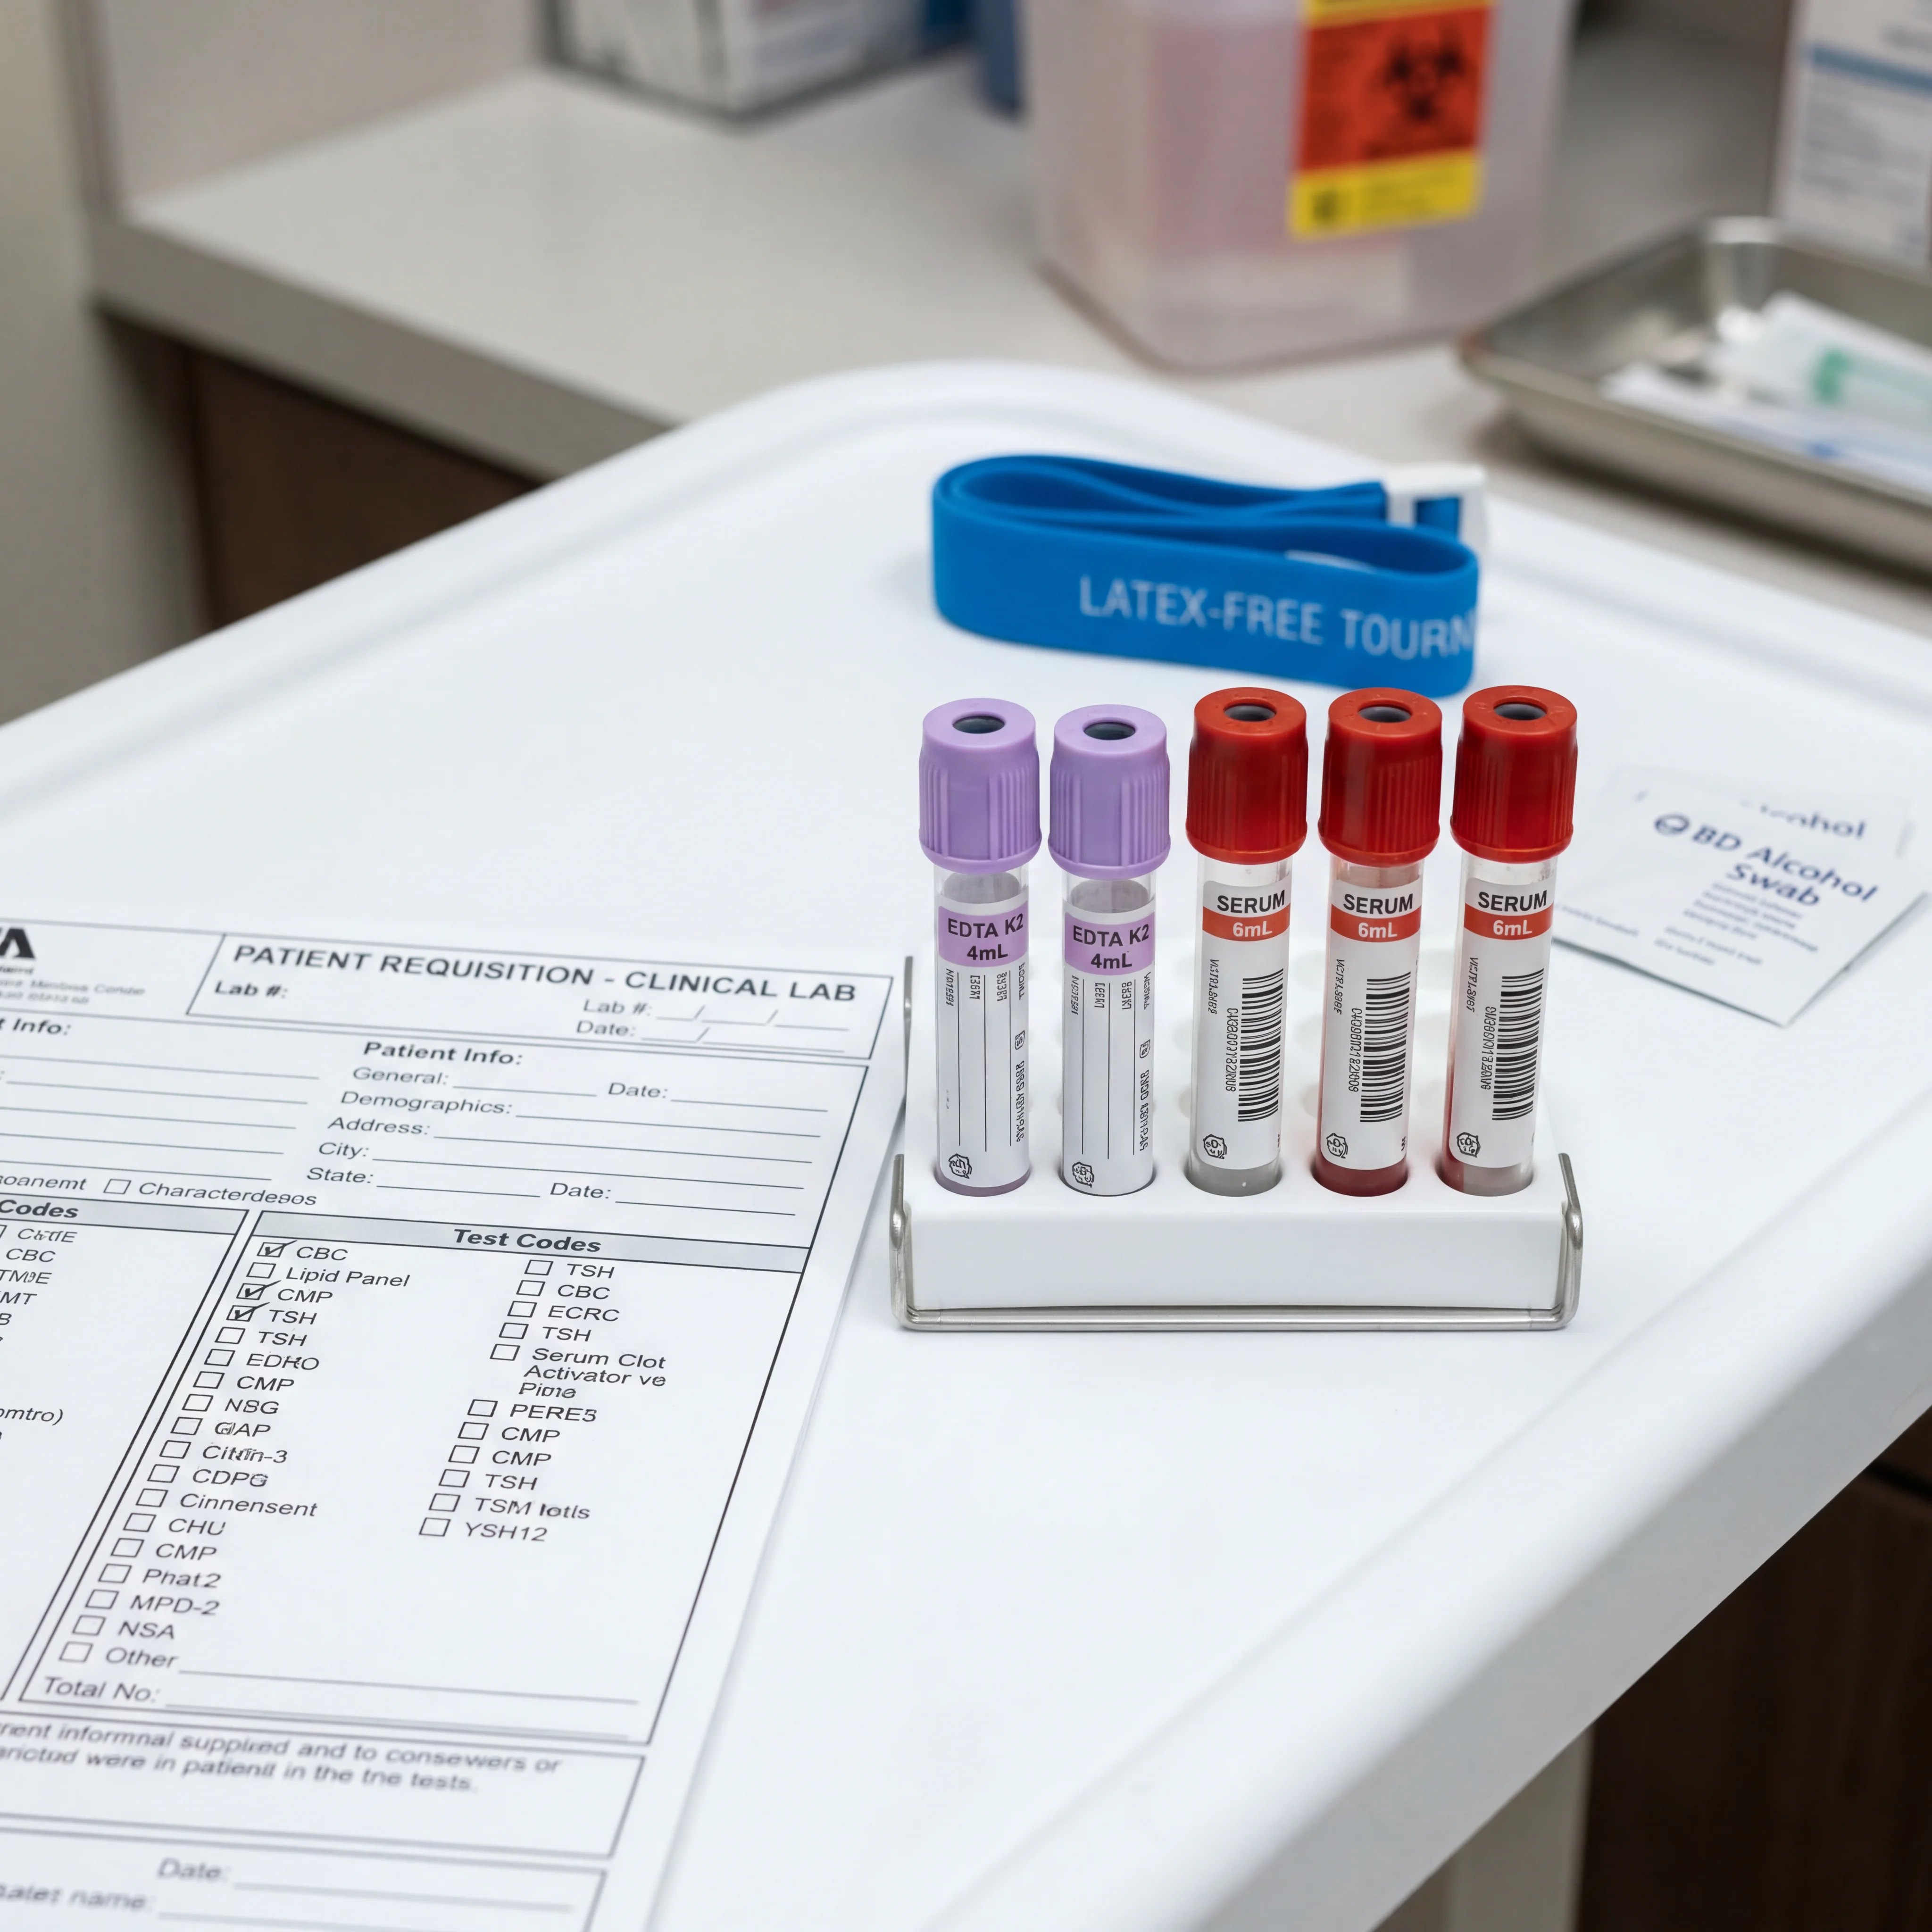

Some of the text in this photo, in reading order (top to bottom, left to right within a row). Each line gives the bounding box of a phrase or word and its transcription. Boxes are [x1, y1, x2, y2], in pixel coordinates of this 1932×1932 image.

[1079, 575, 1324, 645] LATEX-FREE
[1691, 825, 1878, 901] BD Alcohol
[1725, 863, 1820, 906] Swab
[1217, 890, 1285, 914] SERUM
[1343, 893, 1413, 915] SERUM
[1478, 890, 1547, 912] SERUM
[948, 913, 1023, 938] EDTA K2
[1233, 921, 1272, 937] 6mL
[1358, 922, 1397, 938] 6mL
[1493, 920, 1532, 936] 6mL
[1073, 924, 1149, 947] EDTA K2
[967, 944, 1008, 960] 4mL
[1091, 953, 1133, 969] 4mL
[234, 945, 371, 971] PATIENT
[380, 955, 594, 984] REQUISITION
[626, 971, 778, 997] CLINICAL
[789, 983, 855, 1001] LAB
[215, 981, 287, 999] Lab #:
[583, 999, 625, 1014] Lab
[13, 1018, 71, 1036] Info:
[576, 1021, 636, 1037] Date:
[363, 1042, 523, 1065] Patient Info:
[352, 1066, 668, 1099] General: Date:
[341, 1091, 513, 1114] Demographics:
[327, 1116, 430, 1134] Address:
[318, 1142, 369, 1160] City:
[307, 1167, 611, 1199] State: Date:
[0, 1199, 79, 1218] Codes
[453, 1229, 602, 1252] Test Codes
[6, 1249, 56, 1262] CBC
[296, 1247, 348, 1260] CBC
[286, 1267, 410, 1287] Lipid Panel
[566, 1264, 615, 1279] TSH
[277, 1289, 333, 1303] CMP
[557, 1284, 610, 1299] CBC
[269, 1309, 317, 1324] TSH
[548, 1305, 620, 1322] ECRC
[258, 1331, 307, 1346] TSH
[542, 1326, 591, 1341] TSH
[532, 1348, 666, 1368] Serum Clot
[237, 1376, 294, 1391] CMP
[524, 1365, 632, 1384] Activator
[501, 1427, 560, 1442] CMP
[492, 1450, 551, 1466] CMP
[485, 1474, 538, 1491] TSH
[180, 1493, 317, 1516] Cinnensent
[168, 1518, 225, 1535] CHU
[466, 1522, 548, 1541] YSH12
[156, 1543, 217, 1560] CMP
[130, 1595, 220, 1615] MPD-2
[118, 1621, 175, 1639] NSA
[106, 1647, 178, 1668] Other
[45, 1676, 106, 1698] Total
[86, 1751, 146, 1769] were
[154, 1753, 176, 1772] in
[283, 1761, 306, 1780] in
[297, 1743, 347, 1761] and
[354, 1745, 377, 1761] to
[535, 1759, 561, 1774] or
